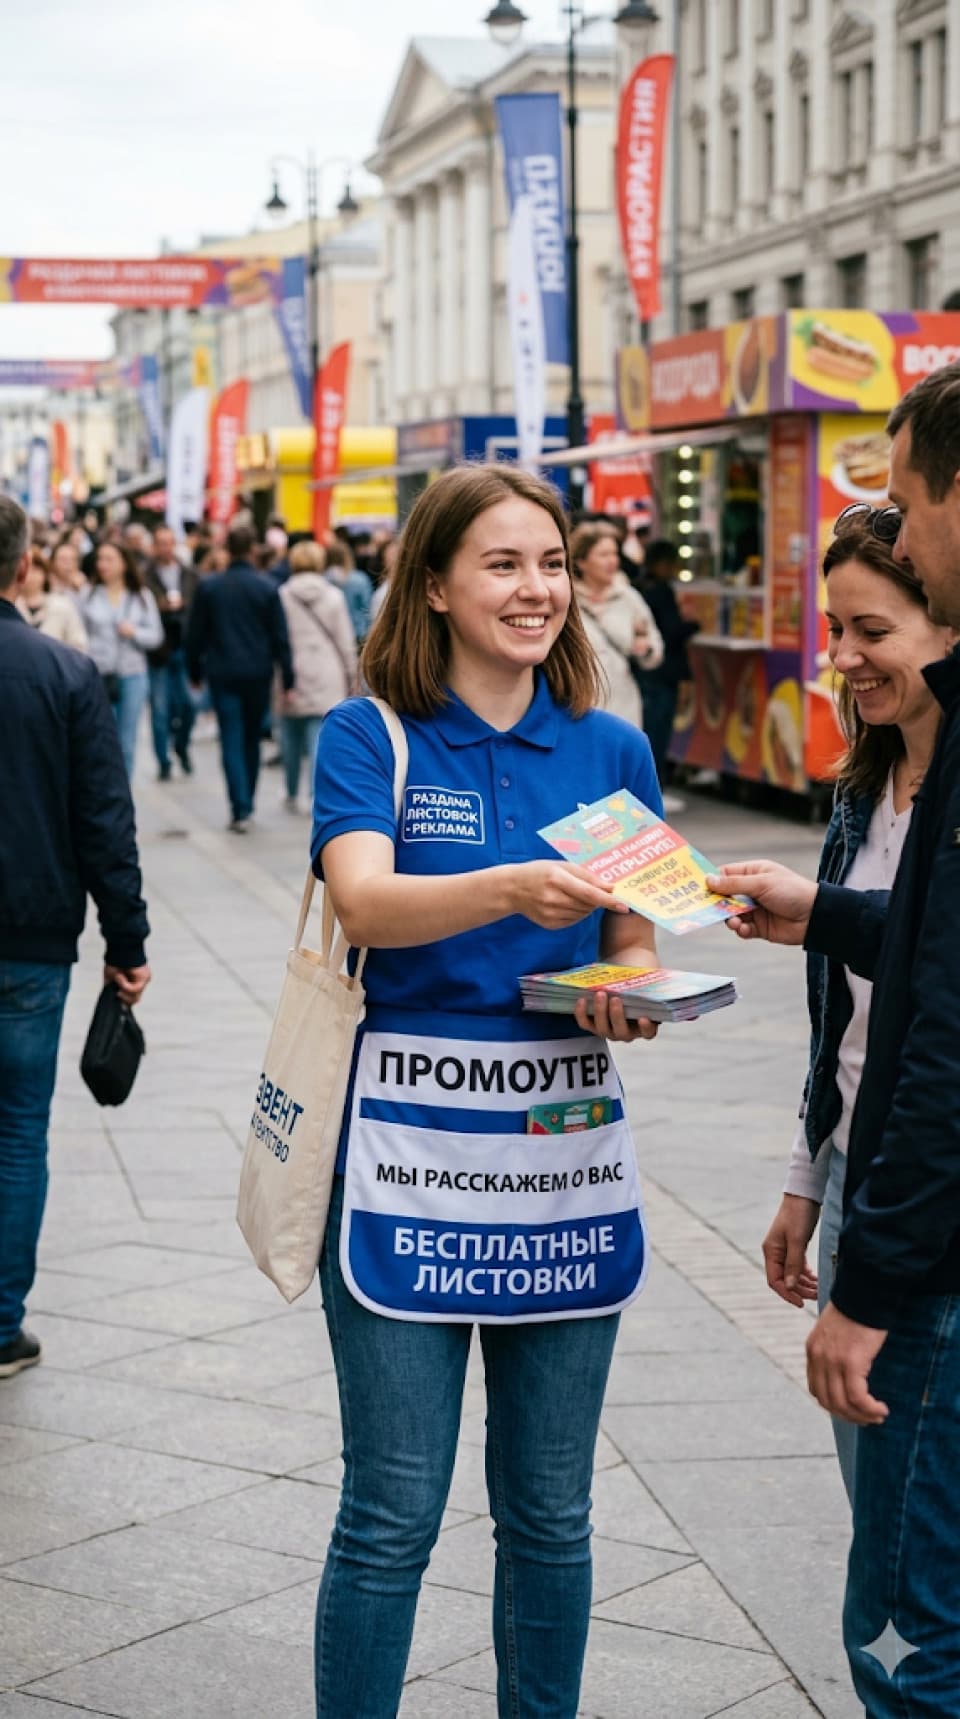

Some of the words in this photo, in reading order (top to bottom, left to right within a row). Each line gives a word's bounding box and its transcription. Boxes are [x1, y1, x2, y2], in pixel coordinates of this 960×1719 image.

[379, 1050, 609, 1094] ПРОМОУТЕР
[376, 1163, 417, 1186] МЫ
[425, 1168, 568, 1192] РАССКАЖЕМ
[572, 1170, 584, 1188] О
[588, 1162, 624, 1185] ВАС
[393, 1225, 616, 1262] БЕСПЛАТНЫЕ
[413, 1262, 597, 1295] ЛИСТОВКИ
